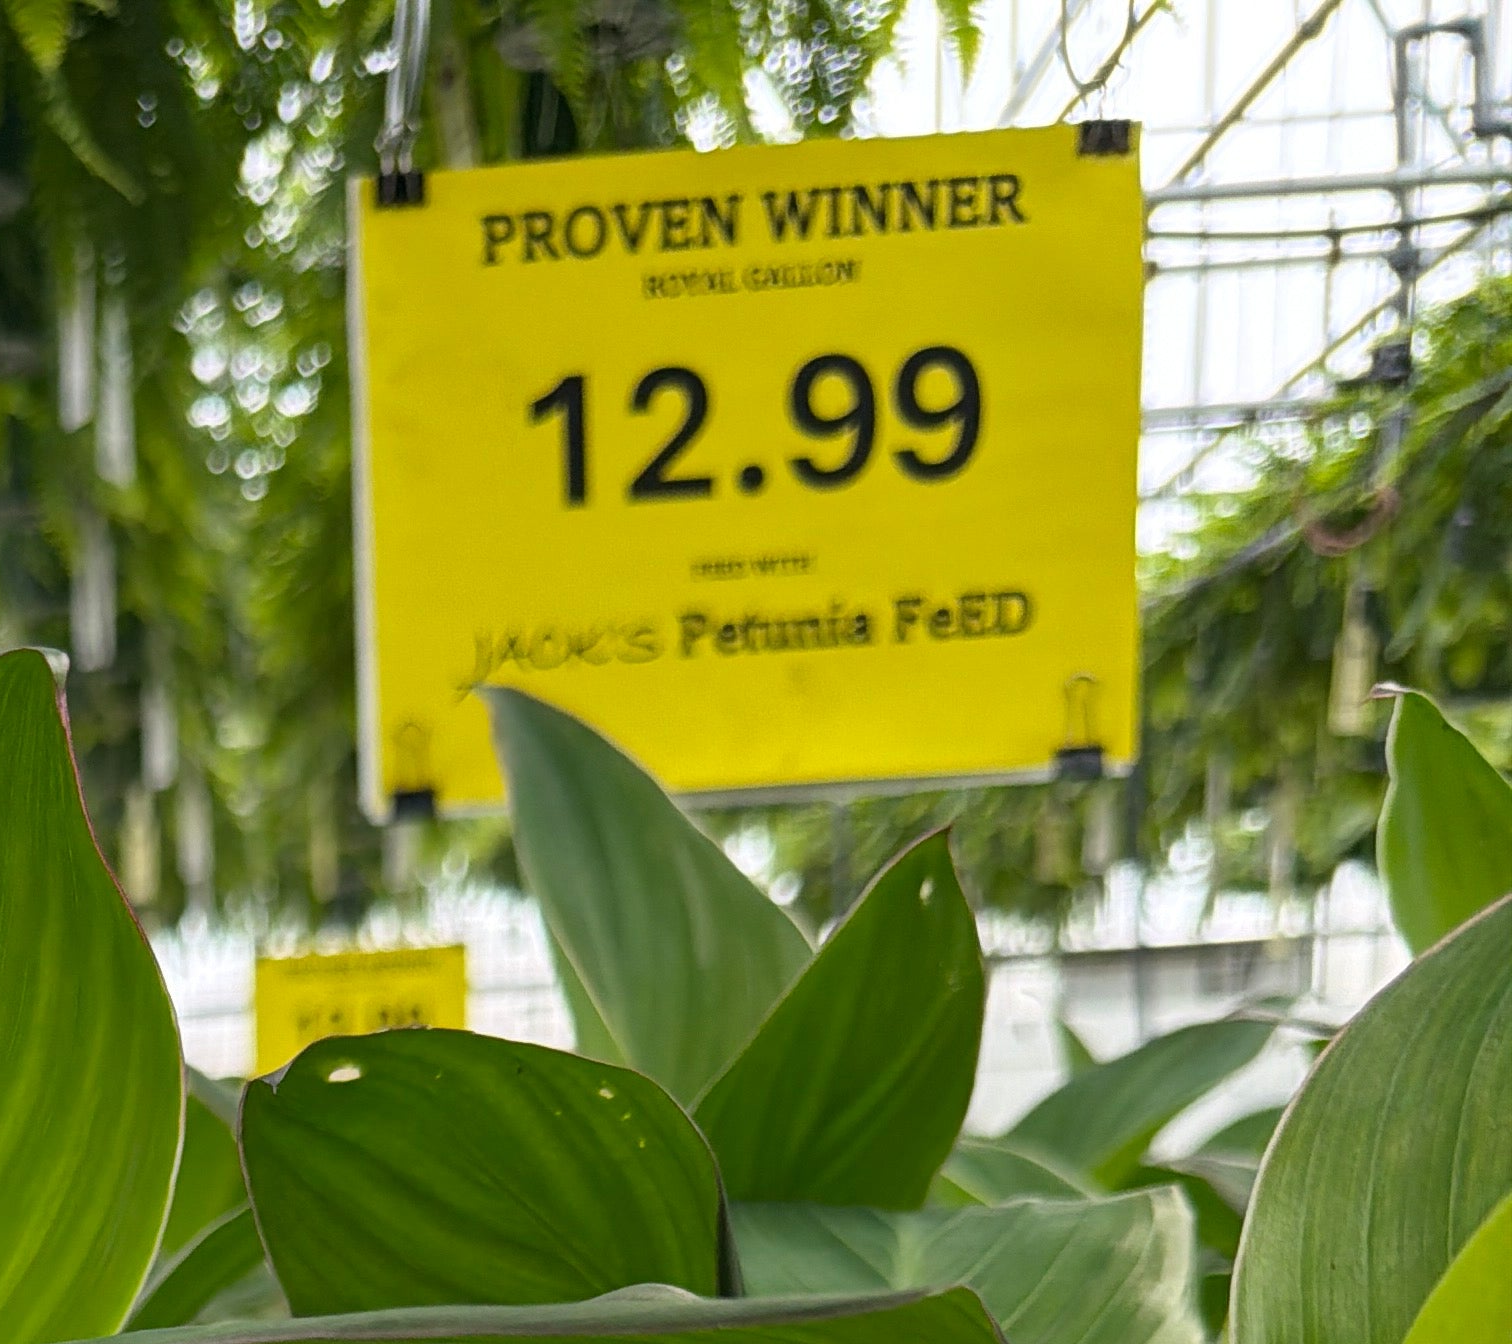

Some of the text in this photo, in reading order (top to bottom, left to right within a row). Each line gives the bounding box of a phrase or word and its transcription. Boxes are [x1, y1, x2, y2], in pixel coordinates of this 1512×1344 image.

[479, 172, 1029, 267] PROVEN WINNER
[526, 344, 985, 510] 12.99
[677, 596, 872, 659] Petunia
